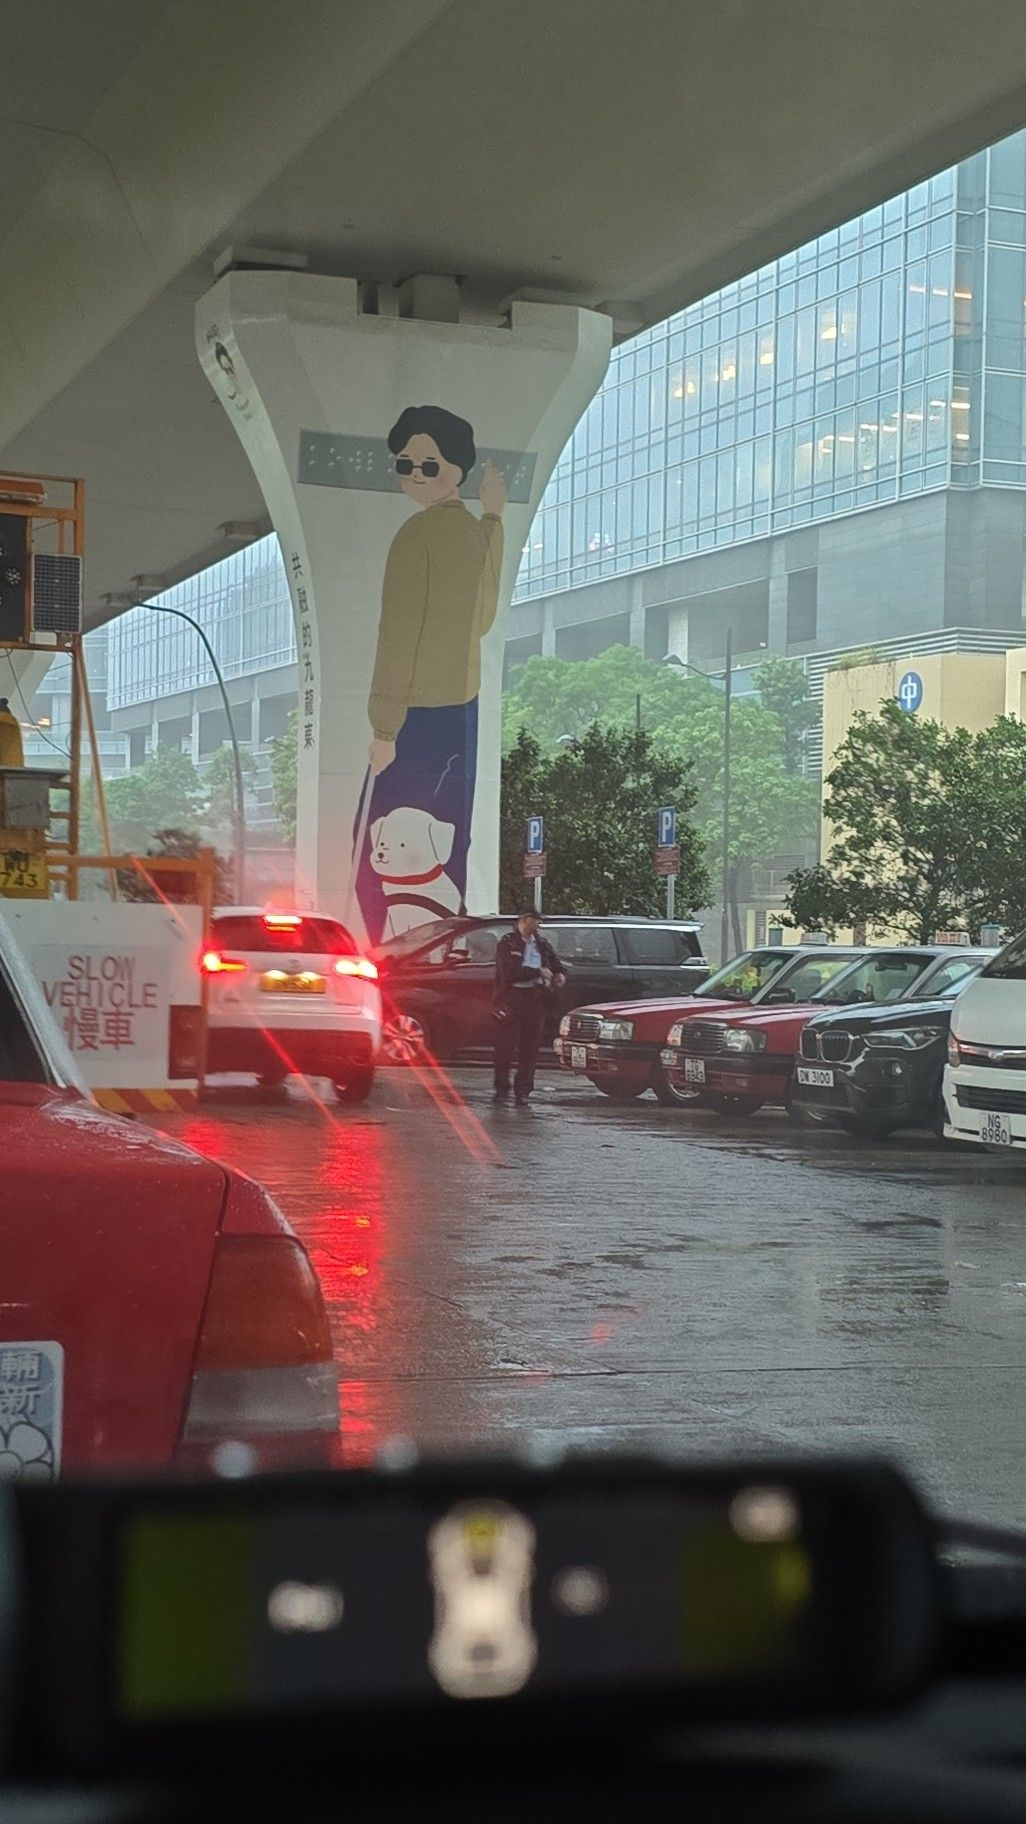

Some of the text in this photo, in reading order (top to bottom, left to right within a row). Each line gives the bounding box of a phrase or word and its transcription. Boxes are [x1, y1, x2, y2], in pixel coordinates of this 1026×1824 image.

[529, 821, 540, 848] P
[662, 811, 671, 842] P
[68, 955, 136, 981] SLOW
[42, 981, 158, 1008] VEHICLE
[63, 1006, 135, 1051] 慢車
[981, 1127, 1008, 1143] 8980
[988, 1114, 1001, 1129] NG
